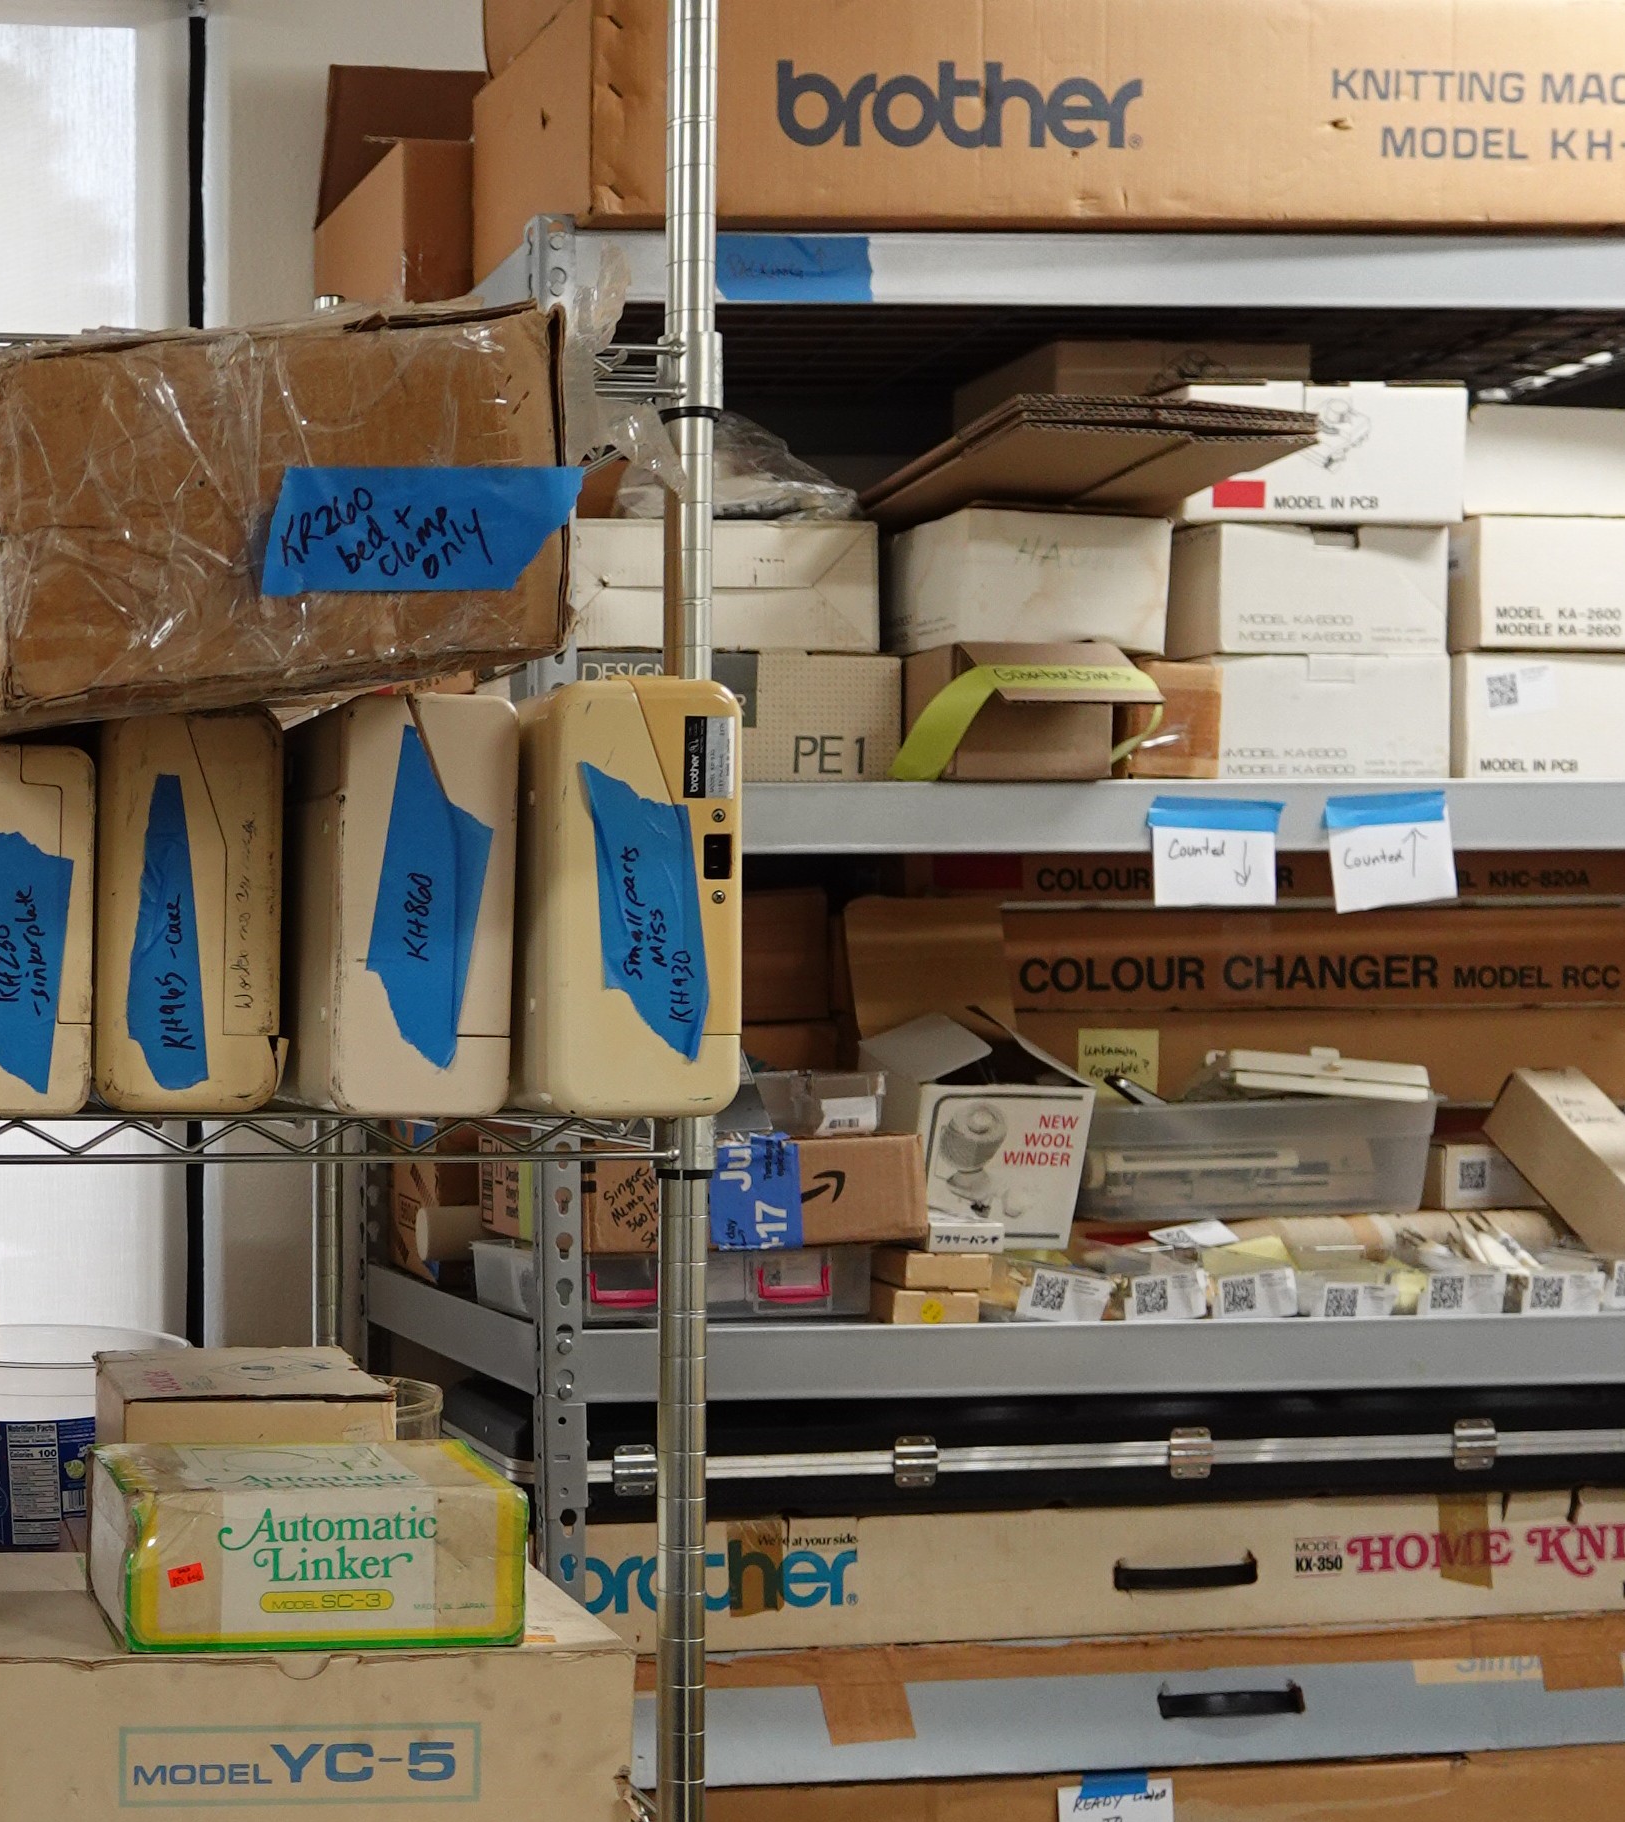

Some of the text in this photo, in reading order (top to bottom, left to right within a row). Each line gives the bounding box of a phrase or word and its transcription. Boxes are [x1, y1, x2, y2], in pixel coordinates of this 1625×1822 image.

[1331, 68, 1525, 103] KNITTING
[777, 60, 1143, 148] brother
[1381, 127, 1528, 160] MODEL
[1274, 496, 1379, 509] MODEL IN PCB
[280, 487, 373, 566] KR260
[336, 515, 390, 574] bed
[422, 508, 493, 579] only
[1496, 606, 1622, 620] MODEL KA-2600
[1496, 622, 1622, 637] MODELE KA-2600
[793, 735, 843, 774] PE
[1480, 759, 1579, 773] MODEL IN PCB
[1036, 867, 1150, 893] COLOUR
[668, 950, 695, 1023] KH930
[1019, 955, 1621, 993] COLOUR CHANGER MODEL RCC
[1039, 1115, 1079, 1130] NEW
[1025, 1133, 1074, 1148] WOOL
[1004, 1151, 1071, 1167] WINDER
[38, 1449, 57, 1458] 100
[217, 1505, 438, 1551] Automatic
[792, 1537, 804, 1547] at
[804, 1537, 832, 1550] your
[253, 1545, 414, 1582] Linker
[1295, 1542, 1342, 1552] MODEL
[1295, 1555, 1343, 1572] KX-350
[1347, 1528, 1513, 1573] HOME
[563, 1539, 858, 1615] brher
[271, 1593, 382, 1610] MODEL SC-3
[133, 1742, 456, 1785] MODEL YC-5
